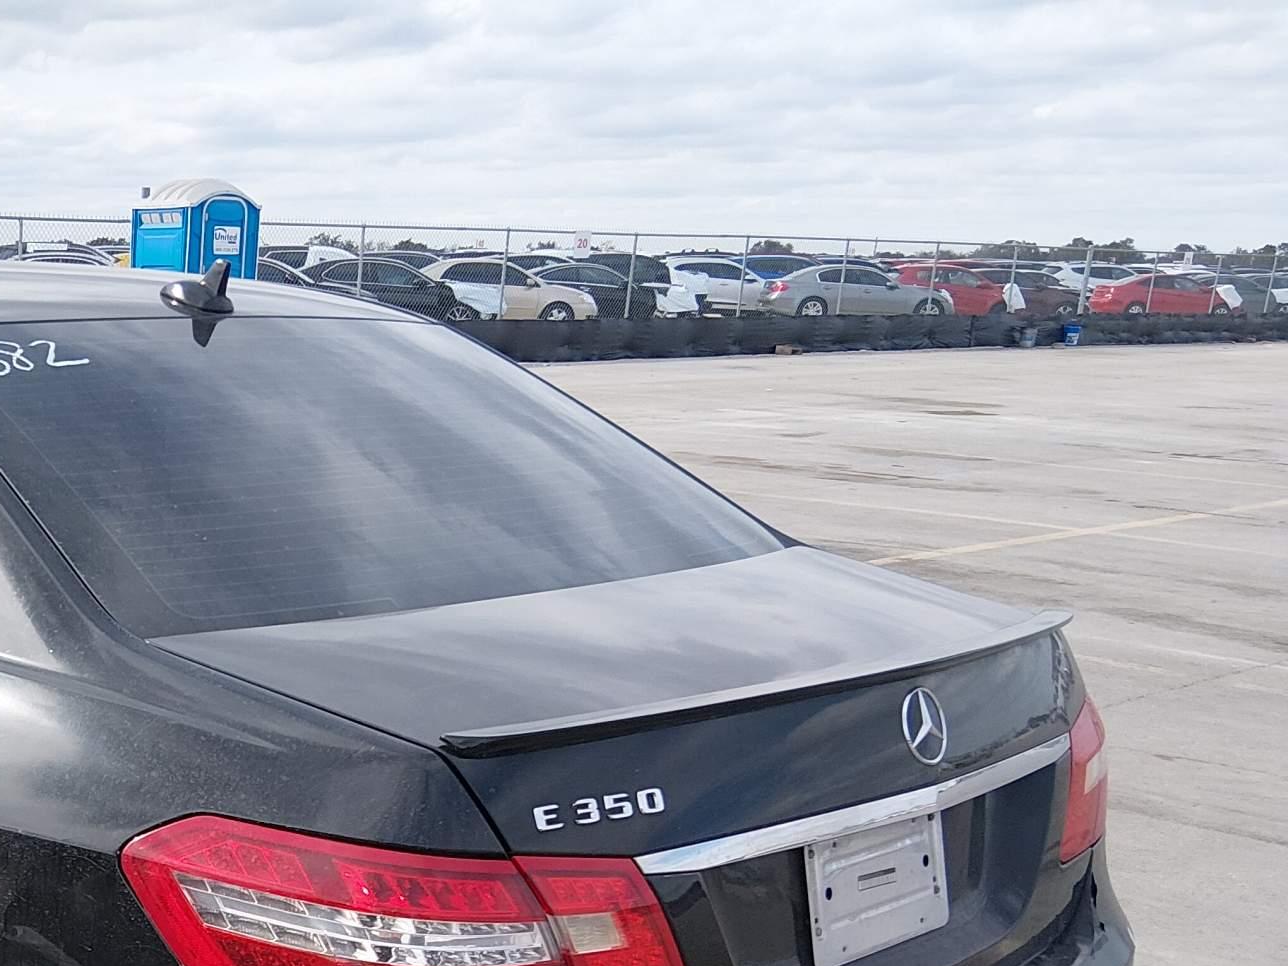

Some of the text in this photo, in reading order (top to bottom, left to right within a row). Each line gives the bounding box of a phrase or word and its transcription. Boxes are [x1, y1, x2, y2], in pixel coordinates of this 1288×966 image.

[215, 232, 238, 241] United
[577, 238, 588, 249] 20
[533, 788, 665, 832] E 350
